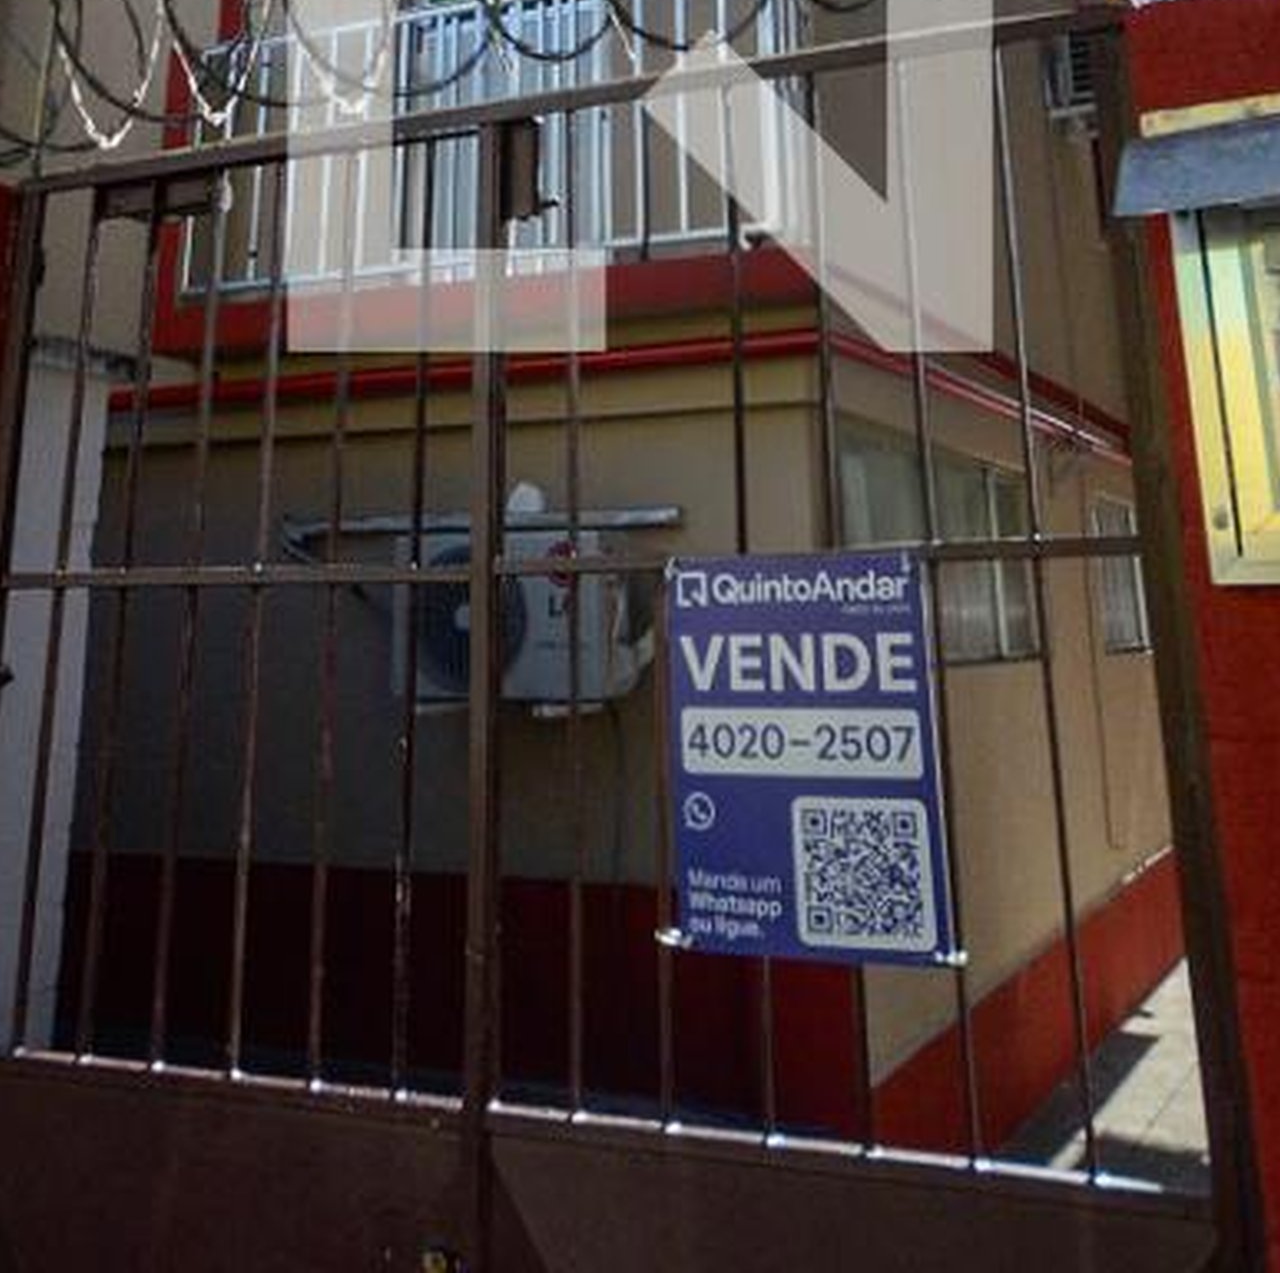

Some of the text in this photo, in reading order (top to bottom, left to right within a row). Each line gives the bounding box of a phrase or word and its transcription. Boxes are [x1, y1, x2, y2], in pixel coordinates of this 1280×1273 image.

[712, 570, 909, 605] QuintoAndar
[679, 632, 918, 692] VENDE
[687, 722, 915, 762] 4020-2507
